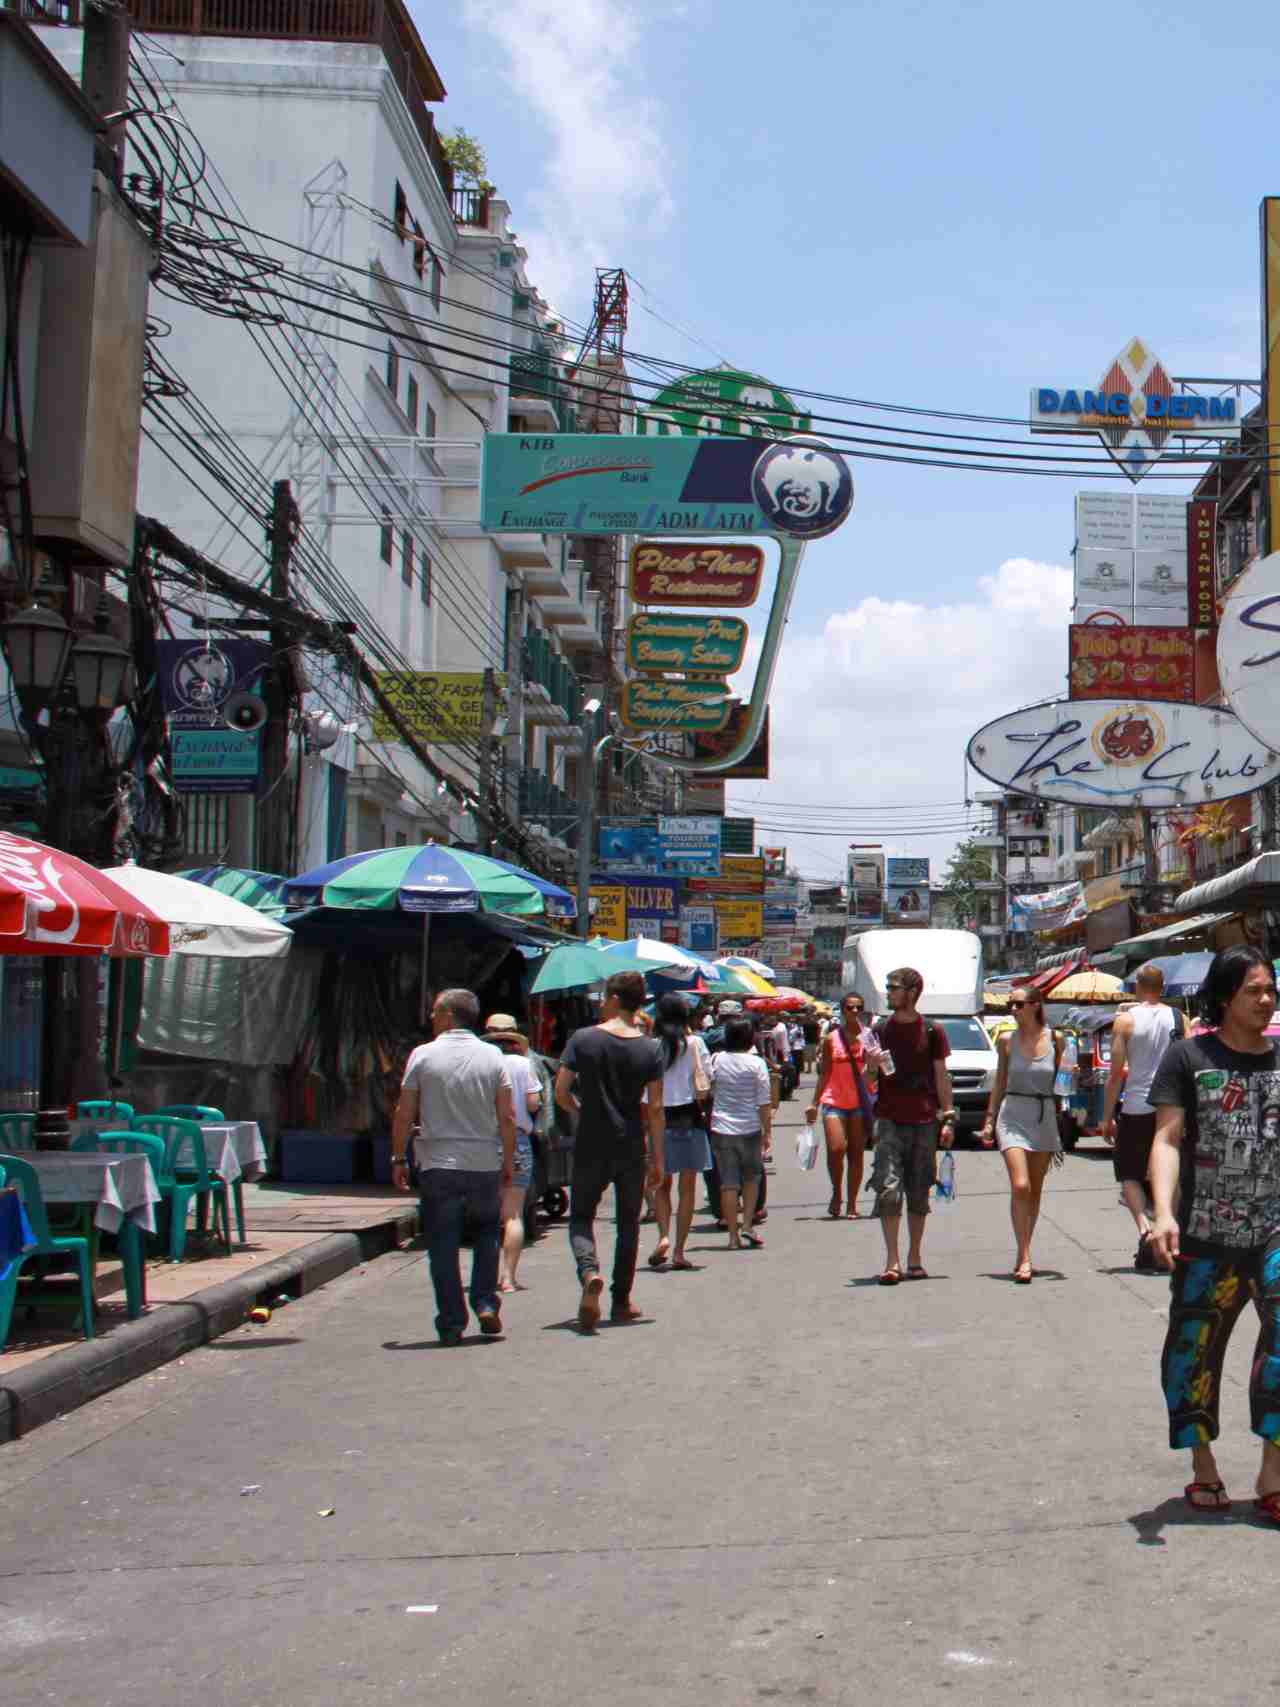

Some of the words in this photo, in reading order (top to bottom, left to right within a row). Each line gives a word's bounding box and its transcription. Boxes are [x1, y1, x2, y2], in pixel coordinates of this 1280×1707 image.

[1038, 388, 1131, 416] DANG
[1146, 394, 1236, 421] DERM
[656, 512, 699, 529] ADM
[716, 512, 754, 529] ATM
[1005, 719, 1103, 785] The
[1142, 741, 1264, 780] Club
[627, 887, 673, 909] SILVER
